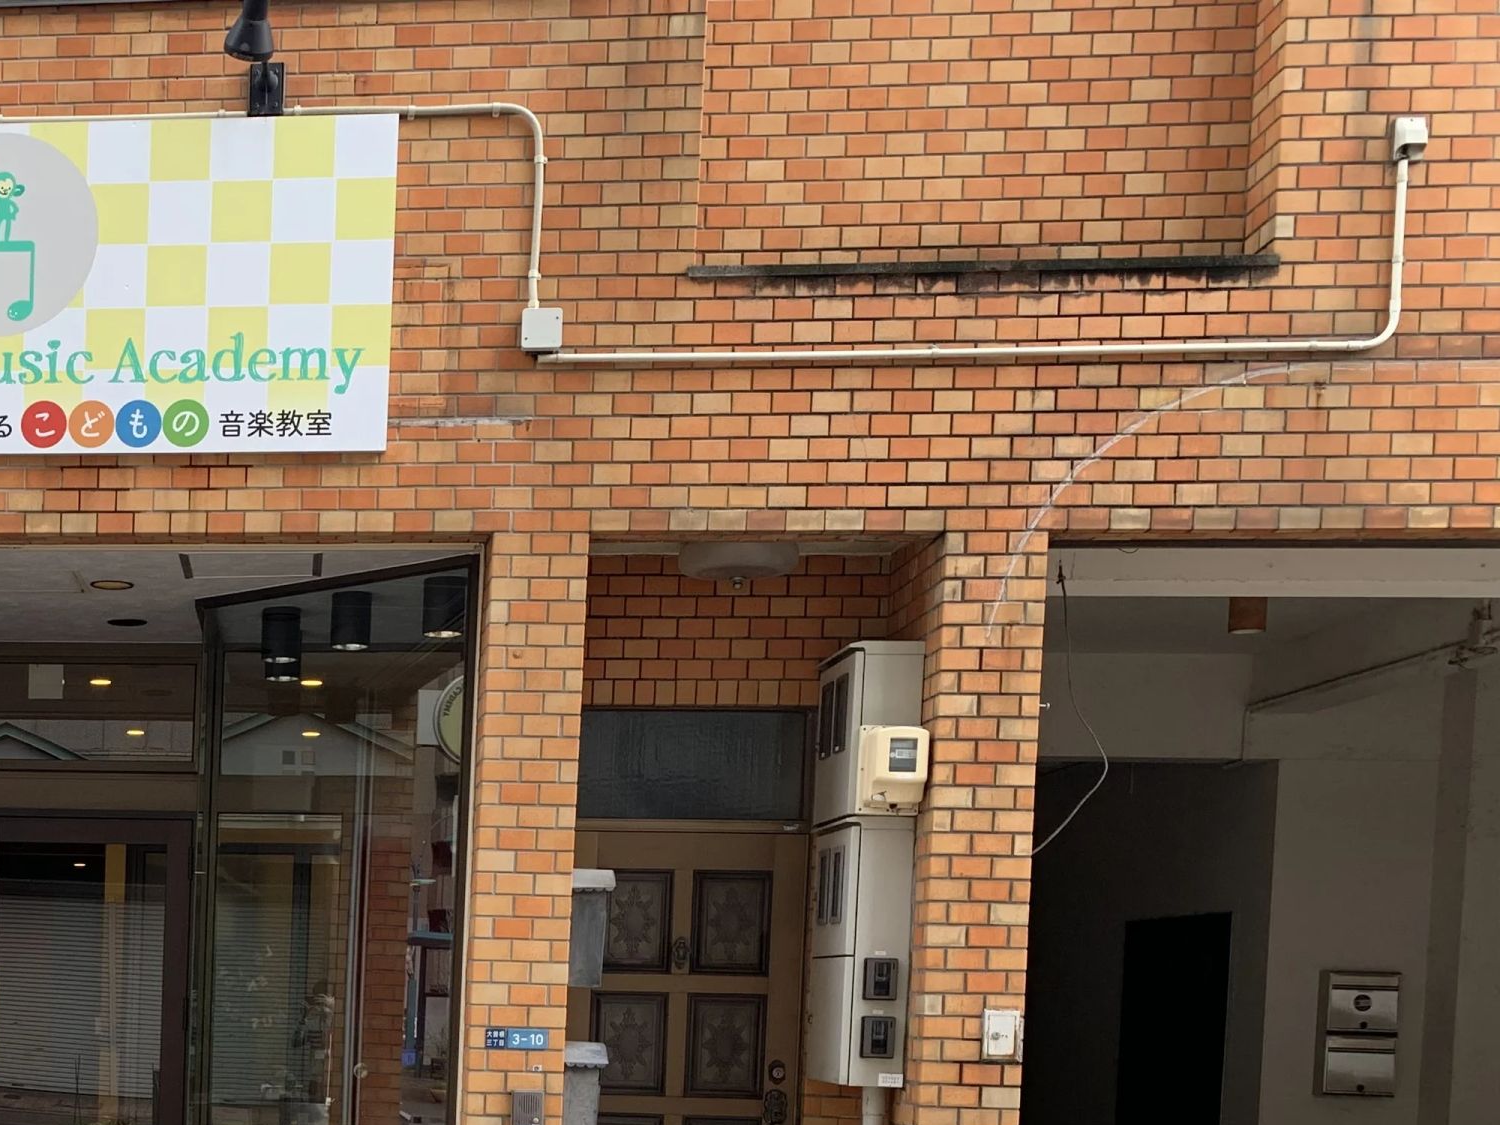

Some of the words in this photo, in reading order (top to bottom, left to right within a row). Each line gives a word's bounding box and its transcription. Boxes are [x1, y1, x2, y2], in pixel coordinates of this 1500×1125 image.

[108, 332, 366, 395] Academy
[218, 408, 333, 438] 音楽教室
[512, 1033, 544, 1046] 3-10
